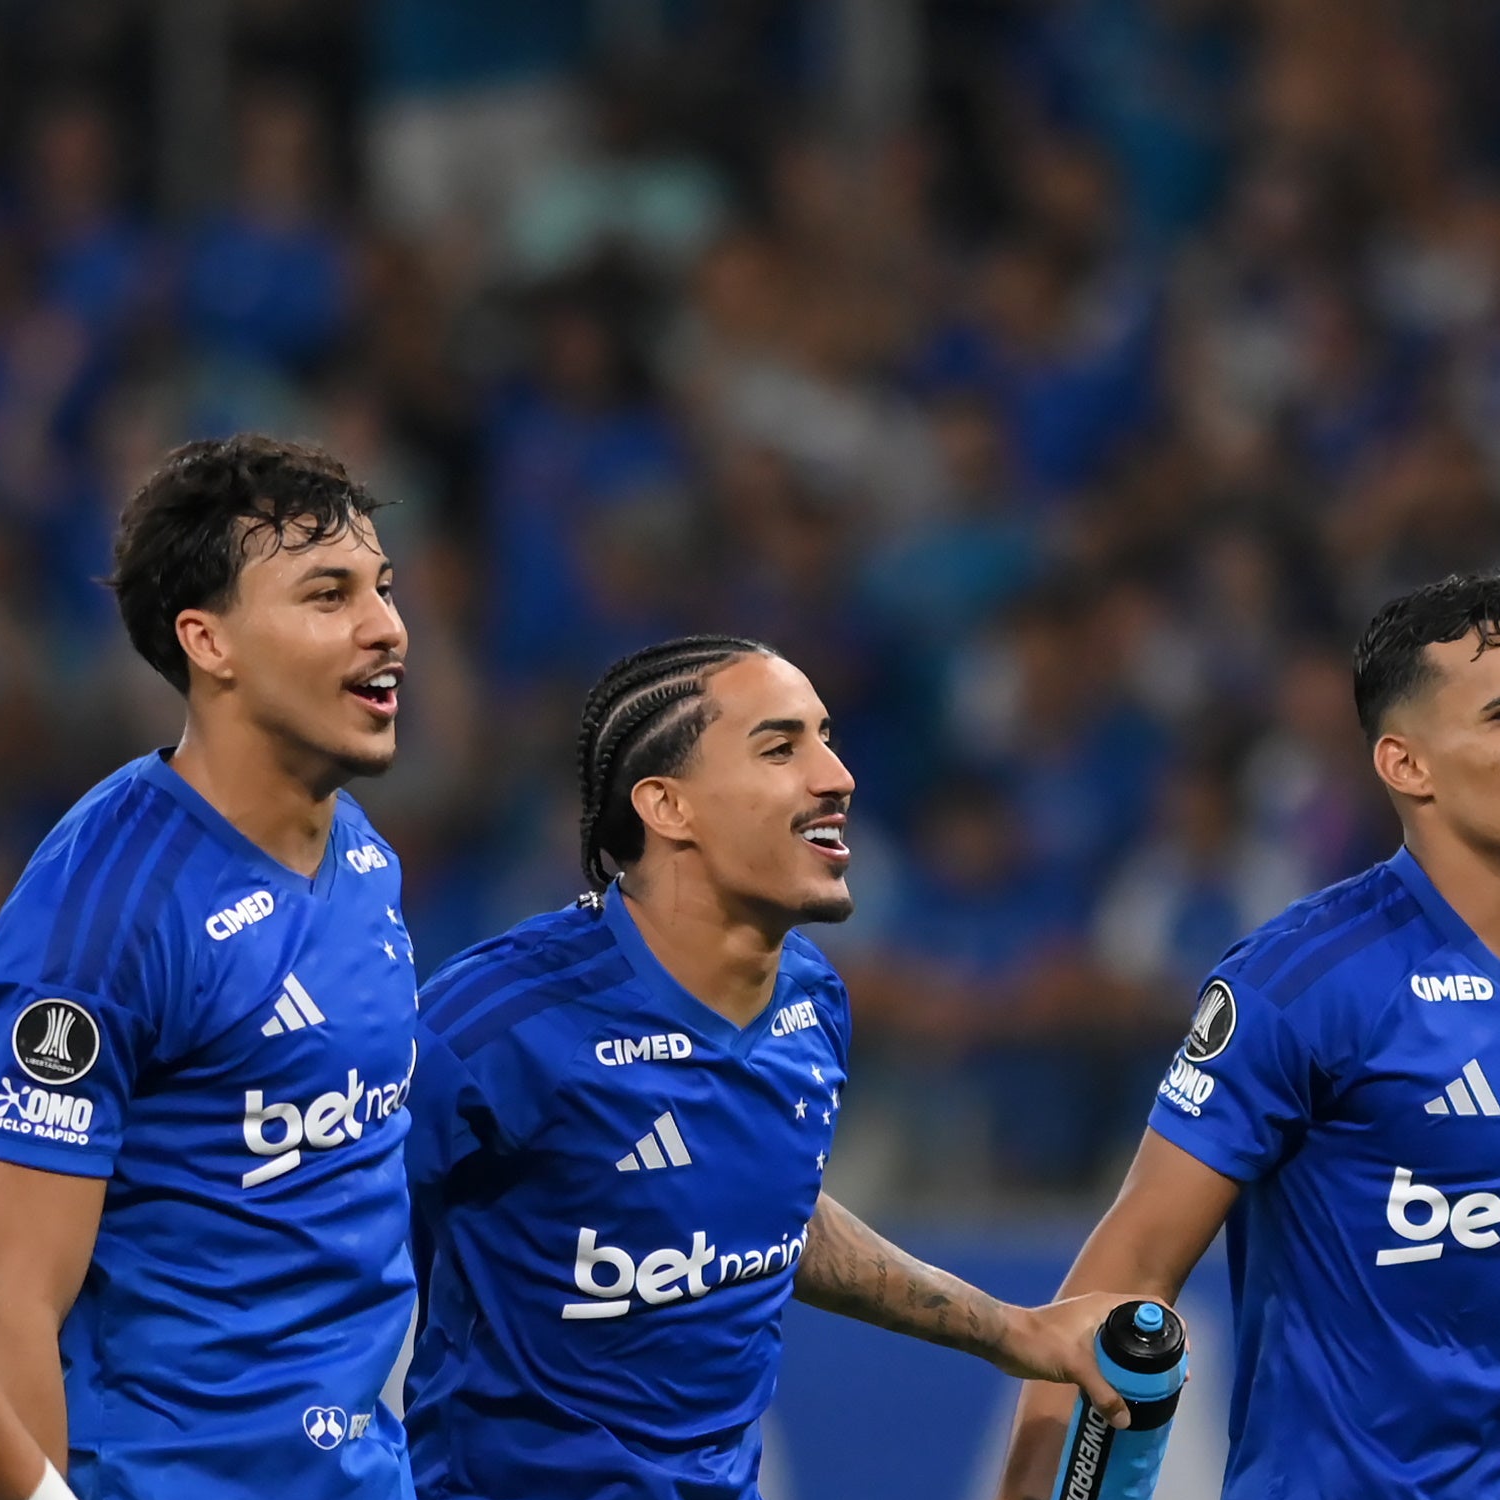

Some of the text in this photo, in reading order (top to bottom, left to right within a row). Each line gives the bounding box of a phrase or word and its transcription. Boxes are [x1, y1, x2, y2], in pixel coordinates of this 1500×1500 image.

[205, 890, 275, 941] CIMED
[1410, 974, 1494, 1001] CIMED
[770, 1000, 818, 1037] CIMED
[24, 1056, 75, 1075] LIBERTADORES
[595, 1033, 693, 1066] CIMED
[25, 1088, 94, 1133] OMO
[34, 1125, 90, 1146] RÁPIDO
